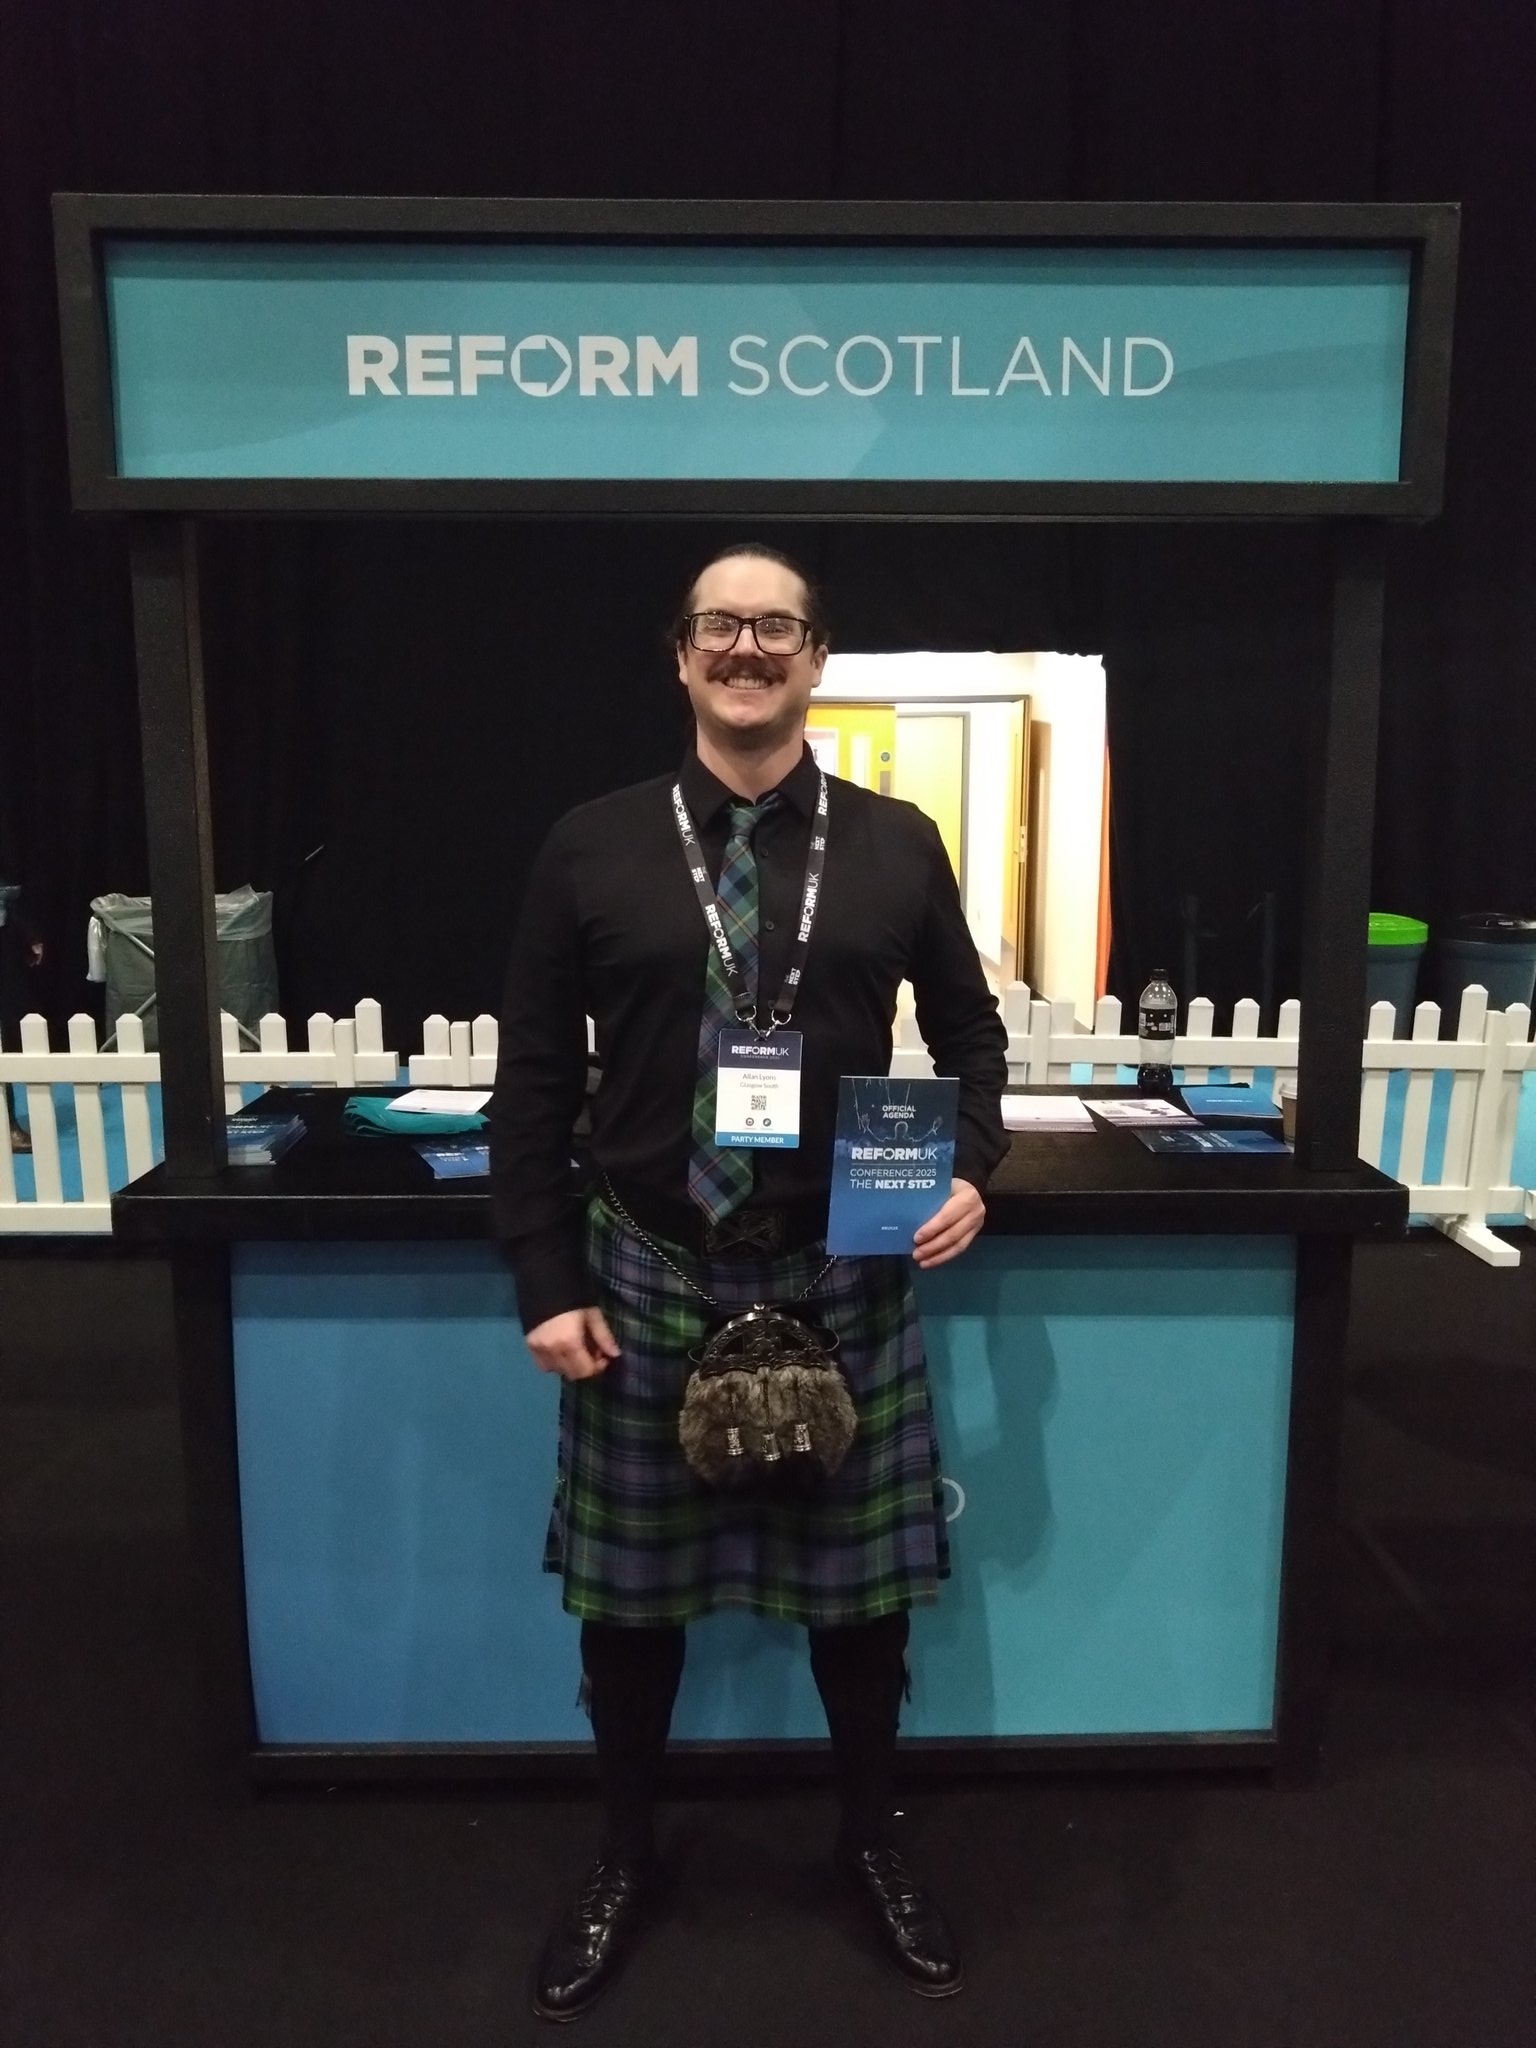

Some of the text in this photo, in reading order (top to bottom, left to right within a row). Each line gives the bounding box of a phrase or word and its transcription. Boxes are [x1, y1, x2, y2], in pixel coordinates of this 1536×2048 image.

[346, 334, 1174, 397] REFORM SCOTLAND
[672, 783, 695, 846] REFORMUK
[797, 873, 819, 942] REFORMUK
[705, 903, 738, 977] REFORMUK
[731, 1045, 790, 1056] REFORMUK
[731, 1135, 784, 1144] PARTY MEMBER
[851, 1147, 937, 1160] REFORMUK
[850, 1168, 937, 1177] CONFERENCE 2025
[850, 1179, 936, 1189] THE NEXT STEP
